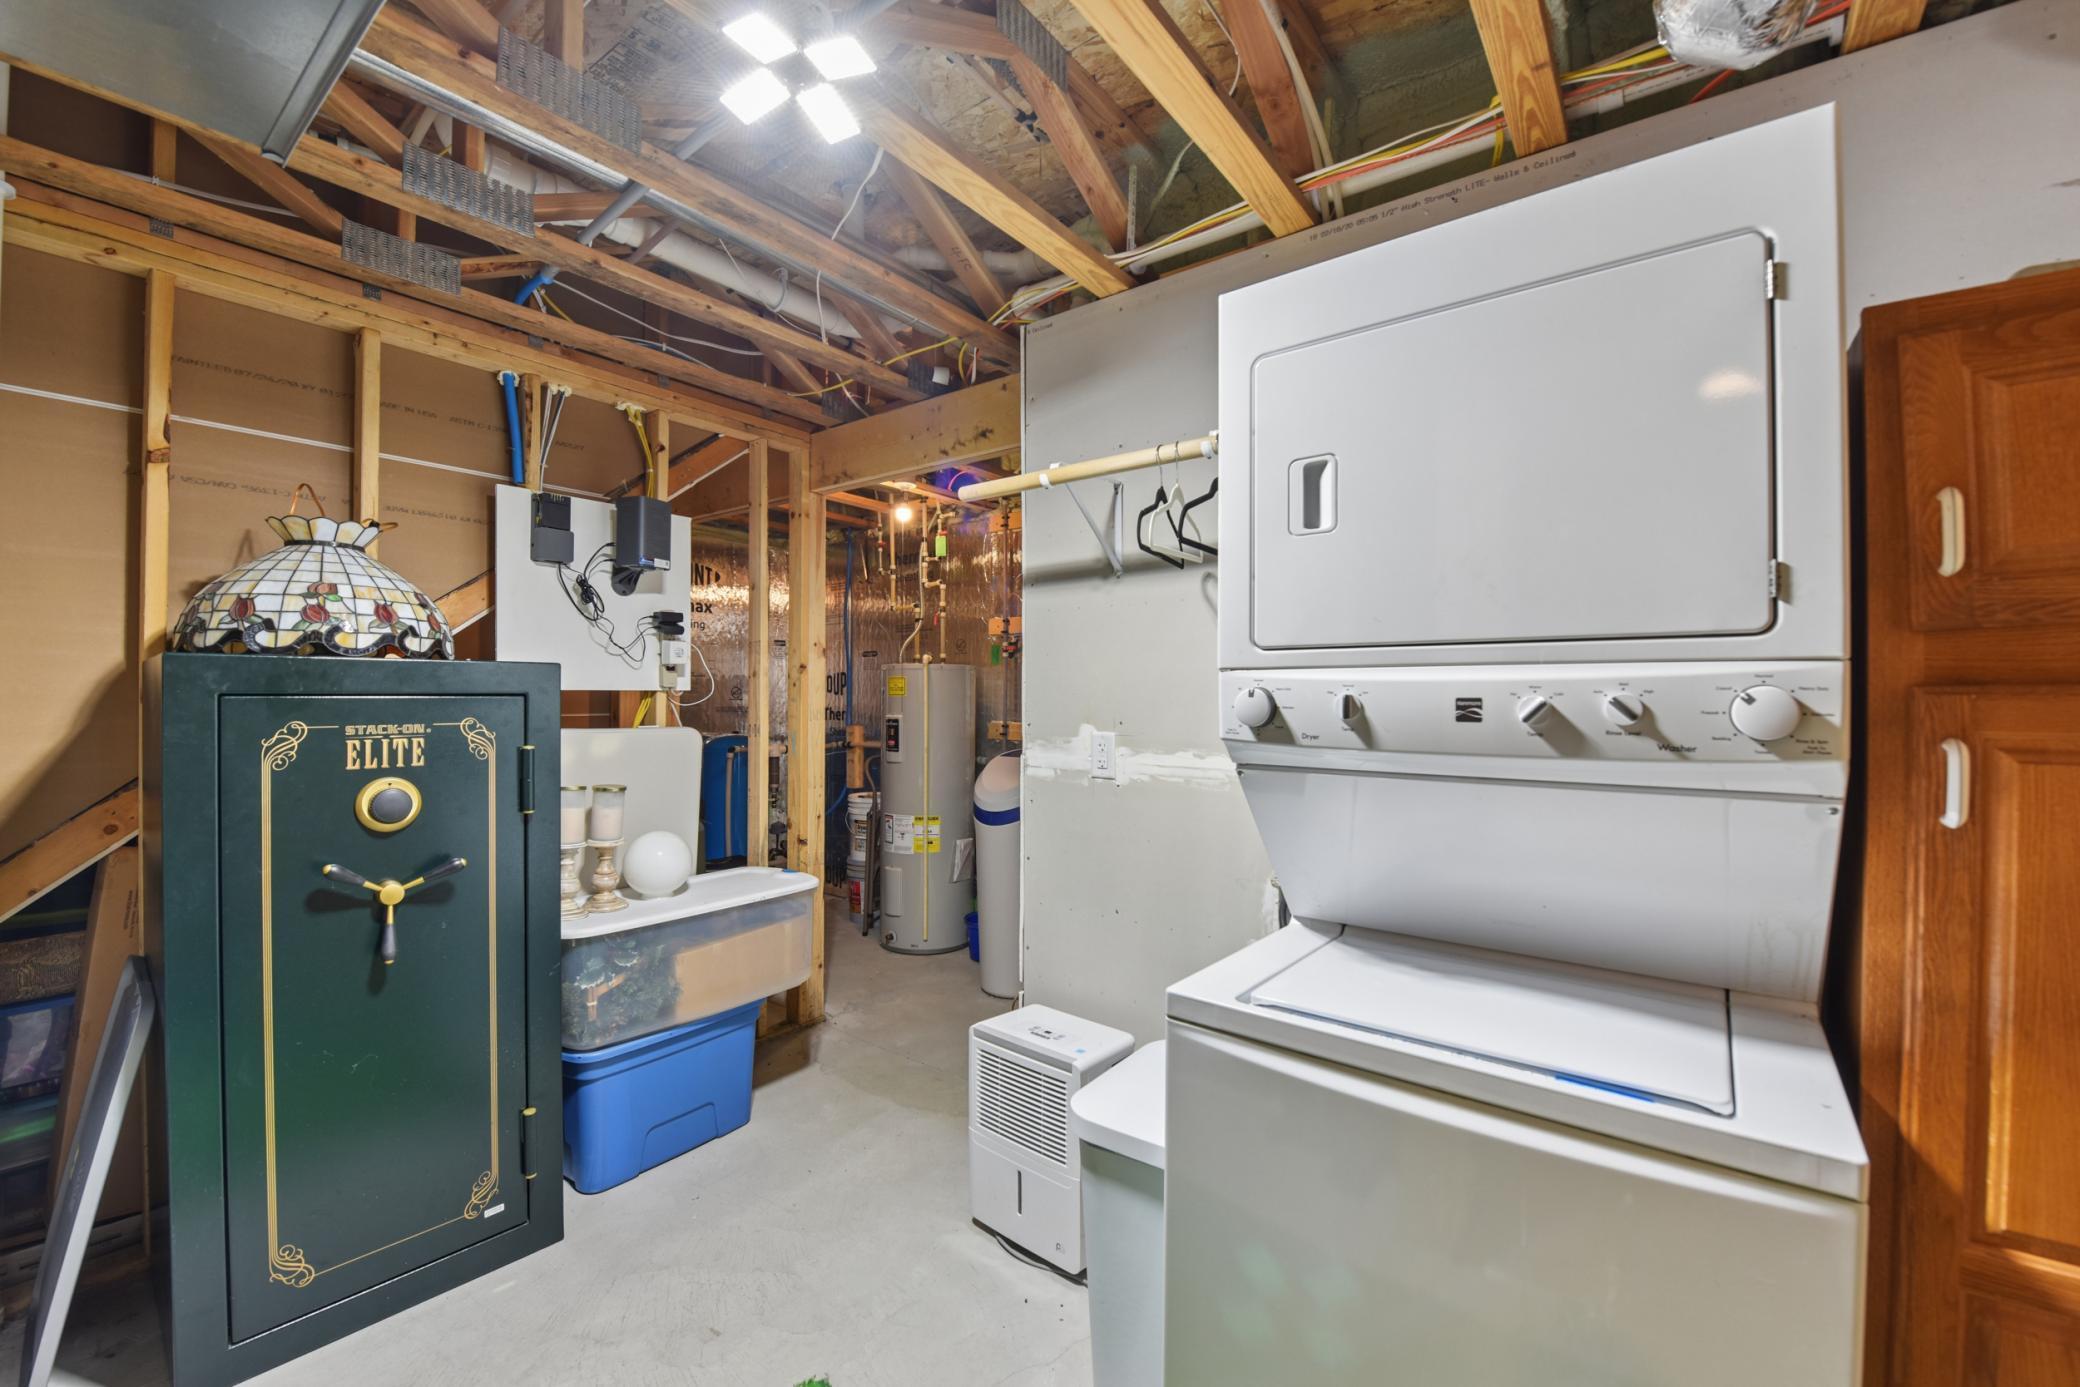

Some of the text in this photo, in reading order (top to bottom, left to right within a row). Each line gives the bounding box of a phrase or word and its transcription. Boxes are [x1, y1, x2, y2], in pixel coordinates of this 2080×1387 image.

[1301, 732, 1320, 742] Dryer
[344, 737, 425, 770] ELITE
[1657, 743, 1697, 755] Washer
